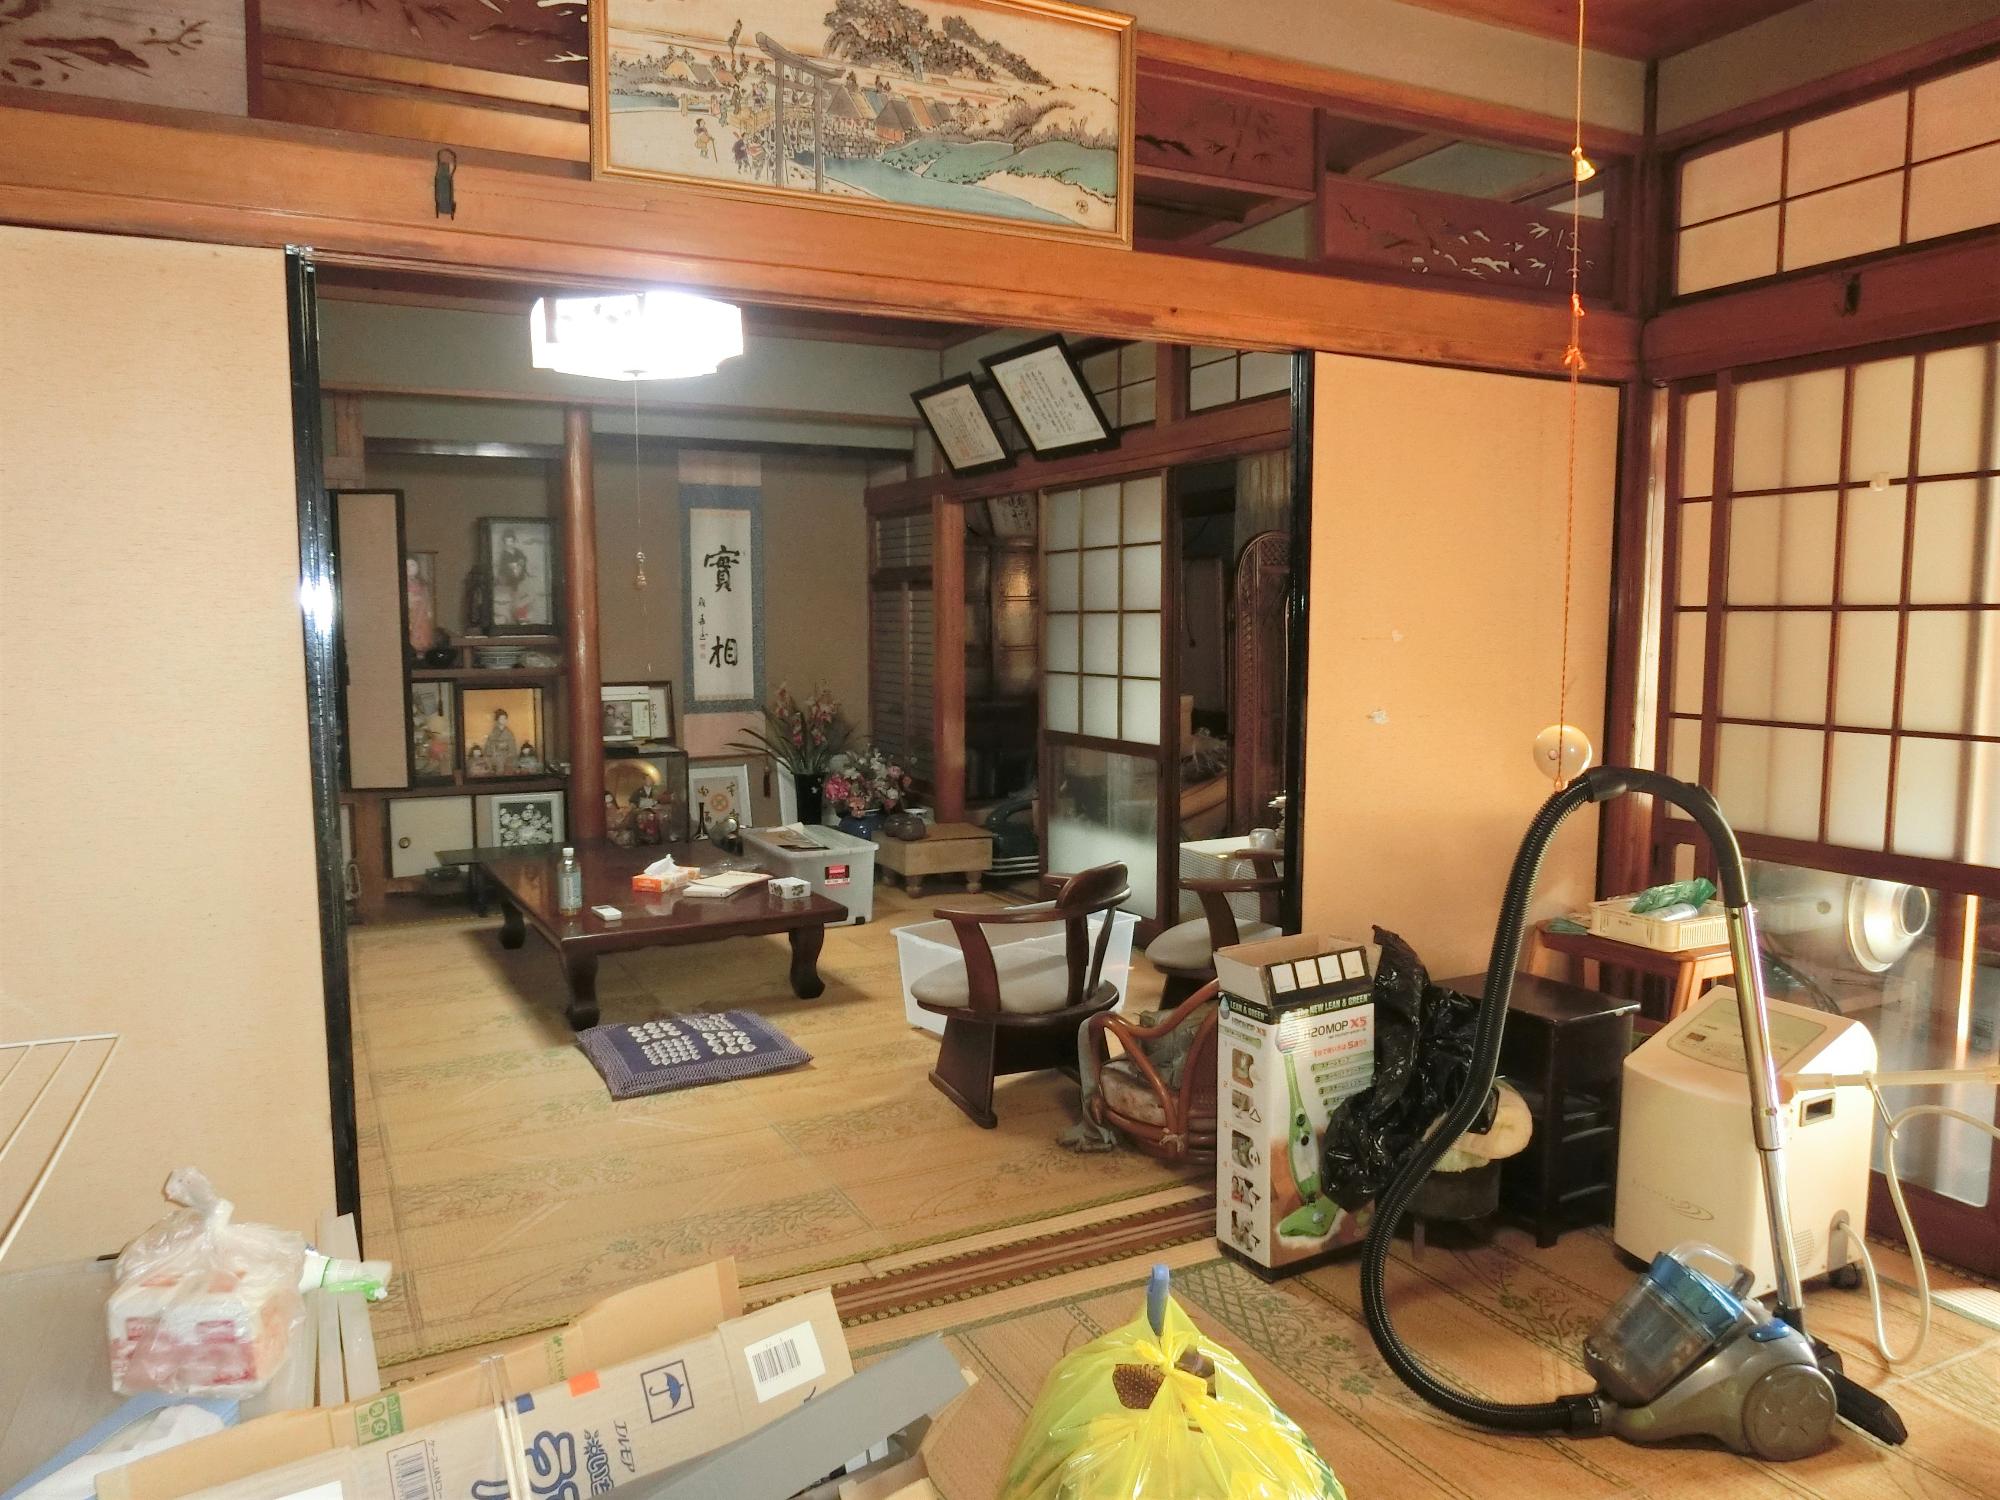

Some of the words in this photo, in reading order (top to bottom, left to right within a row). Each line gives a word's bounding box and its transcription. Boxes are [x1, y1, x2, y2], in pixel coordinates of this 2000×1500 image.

[1310, 1004, 1324, 1015] NEW
[1325, 999, 1341, 1011] LEAN
[613, 1420, 636, 1473] エルモア
